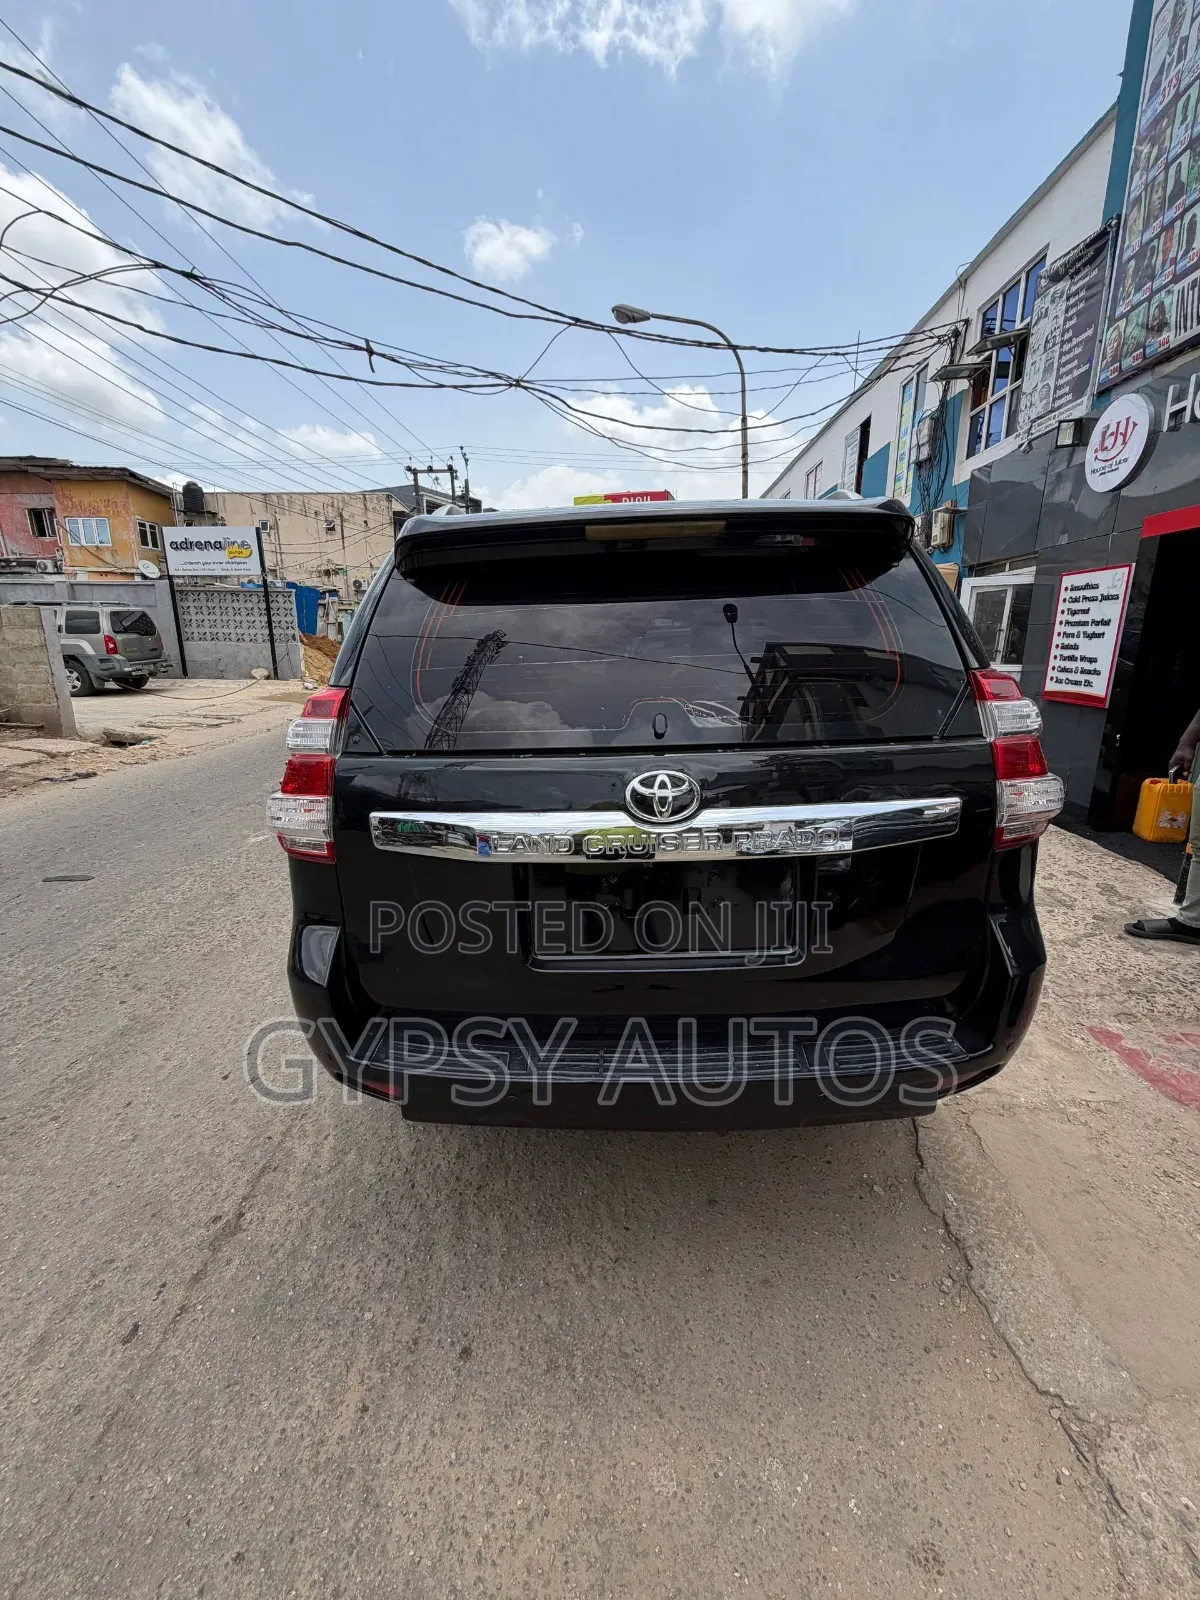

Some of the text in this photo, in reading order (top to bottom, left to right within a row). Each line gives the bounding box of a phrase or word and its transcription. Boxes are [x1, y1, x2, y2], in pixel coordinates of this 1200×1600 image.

[169, 536, 252, 552] adrenaline
[1070, 582, 1099, 592] Smoothies
[1068, 592, 1119, 604] Cold Press Juices
[1067, 607, 1090, 617] Tigernut
[1064, 618, 1111, 627] Premium Parfait
[1082, 631, 1105, 640] Yoghurt
[1060, 642, 1079, 650] Salads
[1059, 654, 1098, 665] Tortilla Wraps
[1074, 666, 1079, 674] &
[1080, 667, 1101, 676] Snacks
[1064, 678, 1082, 686] Cream
[490, 827, 841, 856] LAND CRUISER PRADO
